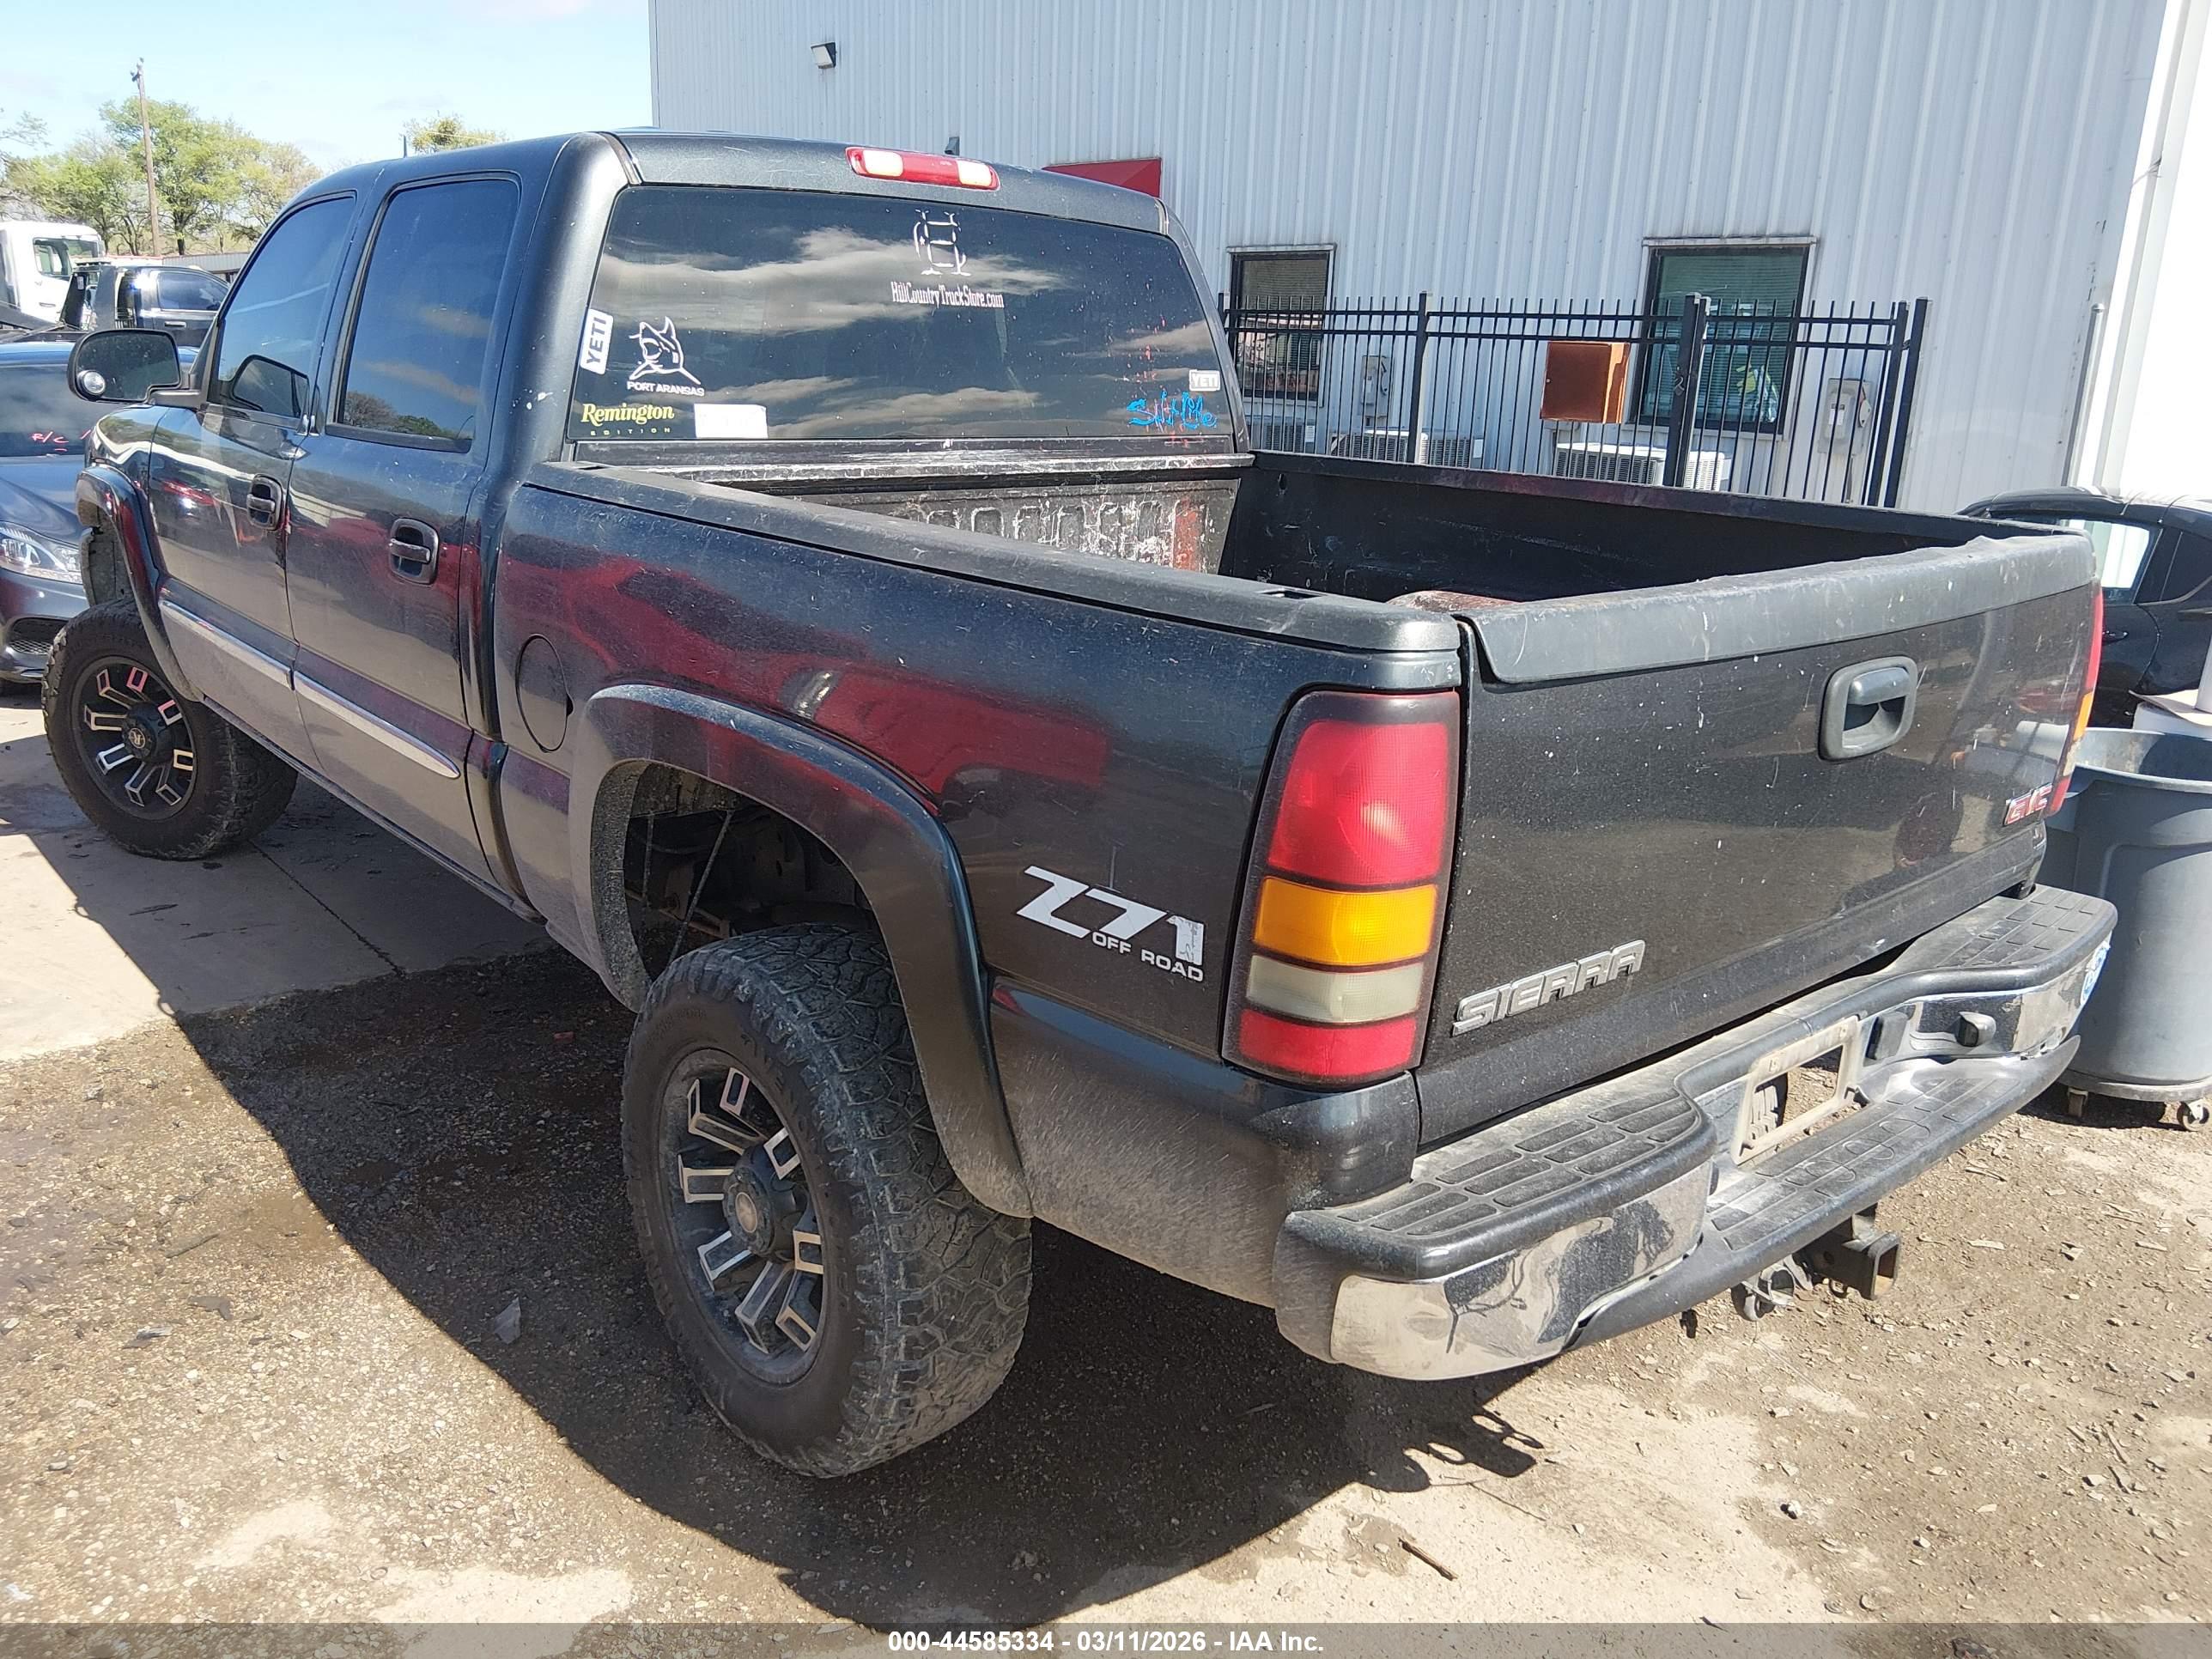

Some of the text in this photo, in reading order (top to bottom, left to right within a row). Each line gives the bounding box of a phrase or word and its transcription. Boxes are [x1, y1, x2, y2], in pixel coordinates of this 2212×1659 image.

[890, 282, 1005, 308] HillCountryTruckStore.com
[586, 317, 606, 365] YETI
[627, 381, 705, 397] PORT ARANSAS
[580, 402, 674, 426] Remington
[590, 427, 671, 436] EDITION
[1016, 865, 1205, 966] Z71
[1092, 932, 1204, 982] OFF ROAD
[1452, 939, 1646, 1038] SIERRA
